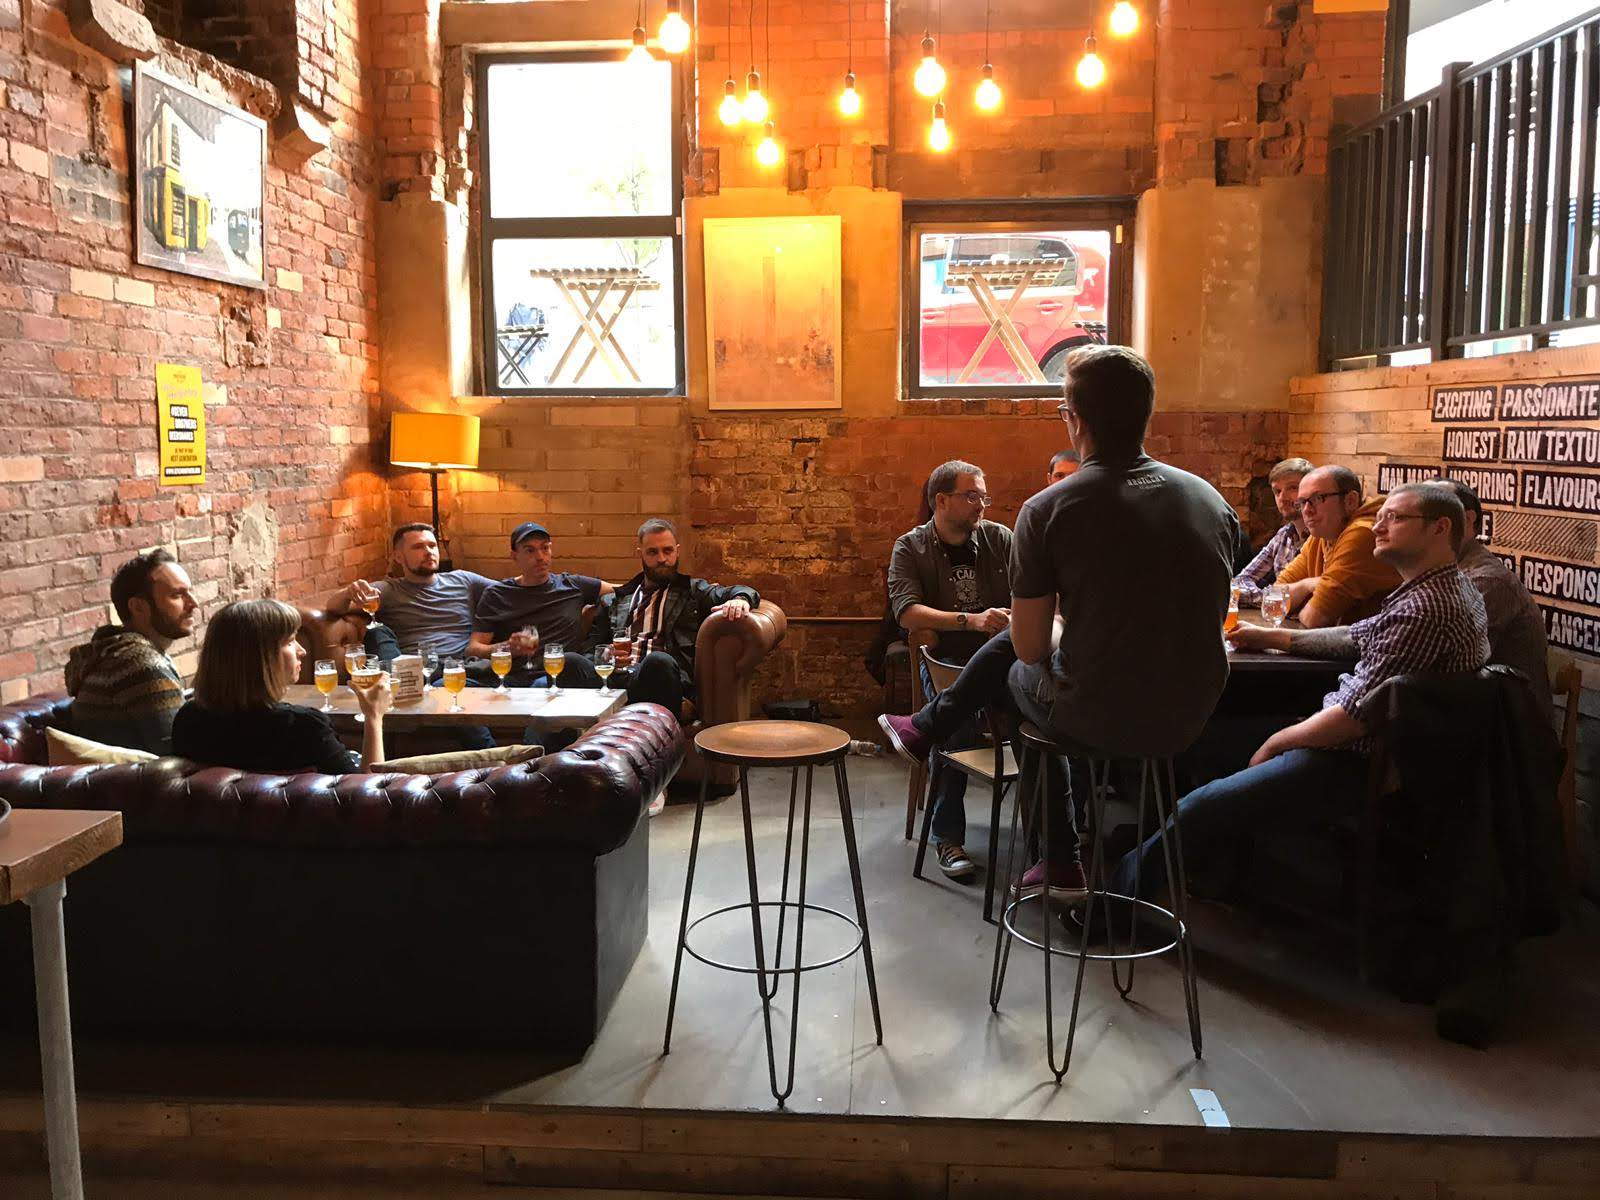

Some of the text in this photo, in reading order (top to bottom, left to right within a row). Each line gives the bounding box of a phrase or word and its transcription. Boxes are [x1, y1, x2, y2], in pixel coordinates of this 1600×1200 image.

[1434, 389, 1493, 418] EXCITING
[1502, 384, 1600, 418] PASSIONATE
[1446, 431, 1497, 459] HONEST
[1506, 430, 1542, 459] RAW
[1380, 467, 1404, 491] MAN
